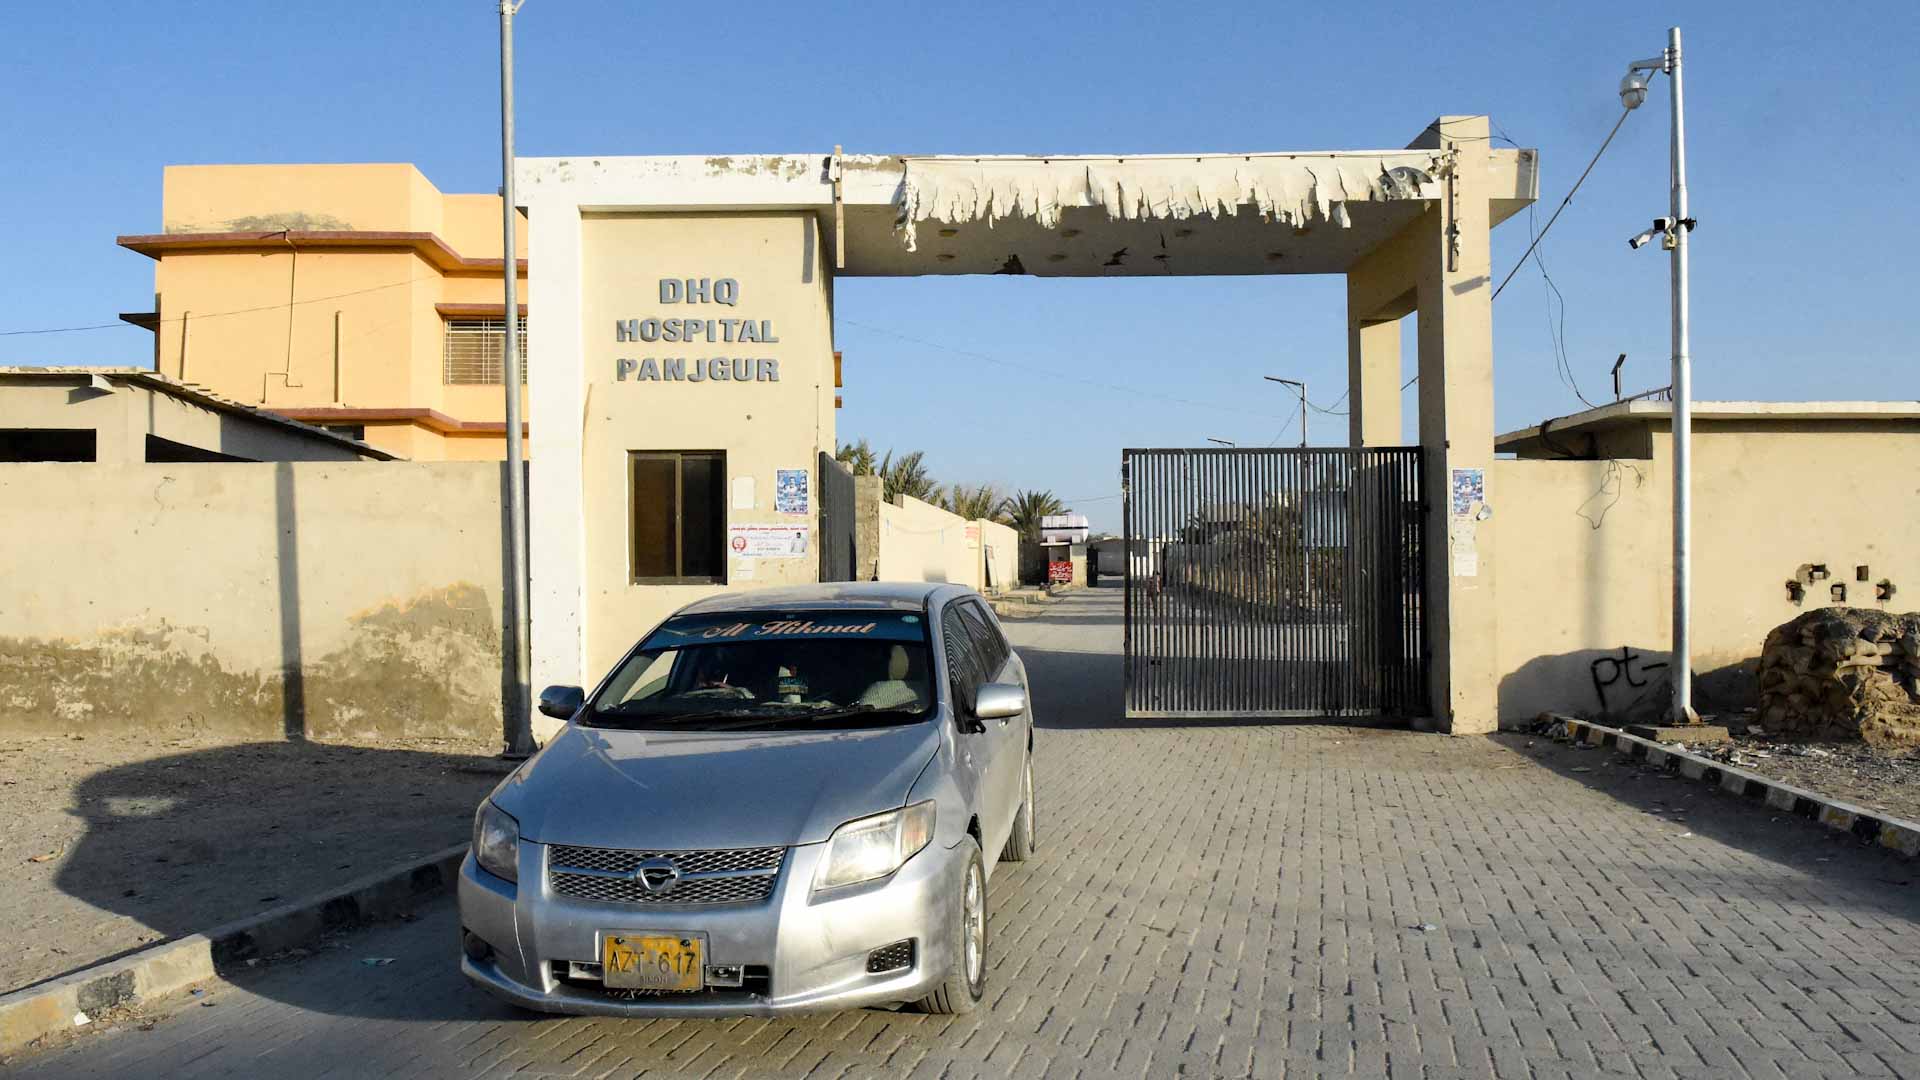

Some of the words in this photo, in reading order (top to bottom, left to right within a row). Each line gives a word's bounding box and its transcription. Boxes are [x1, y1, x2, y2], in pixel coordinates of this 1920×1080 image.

[659, 278, 740, 307] DHQ
[616, 318, 780, 343] HOSPITAL
[616, 357, 781, 383] PANJGUR
[703, 622, 750, 638] Al
[753, 620, 877, 636] Hikmat
